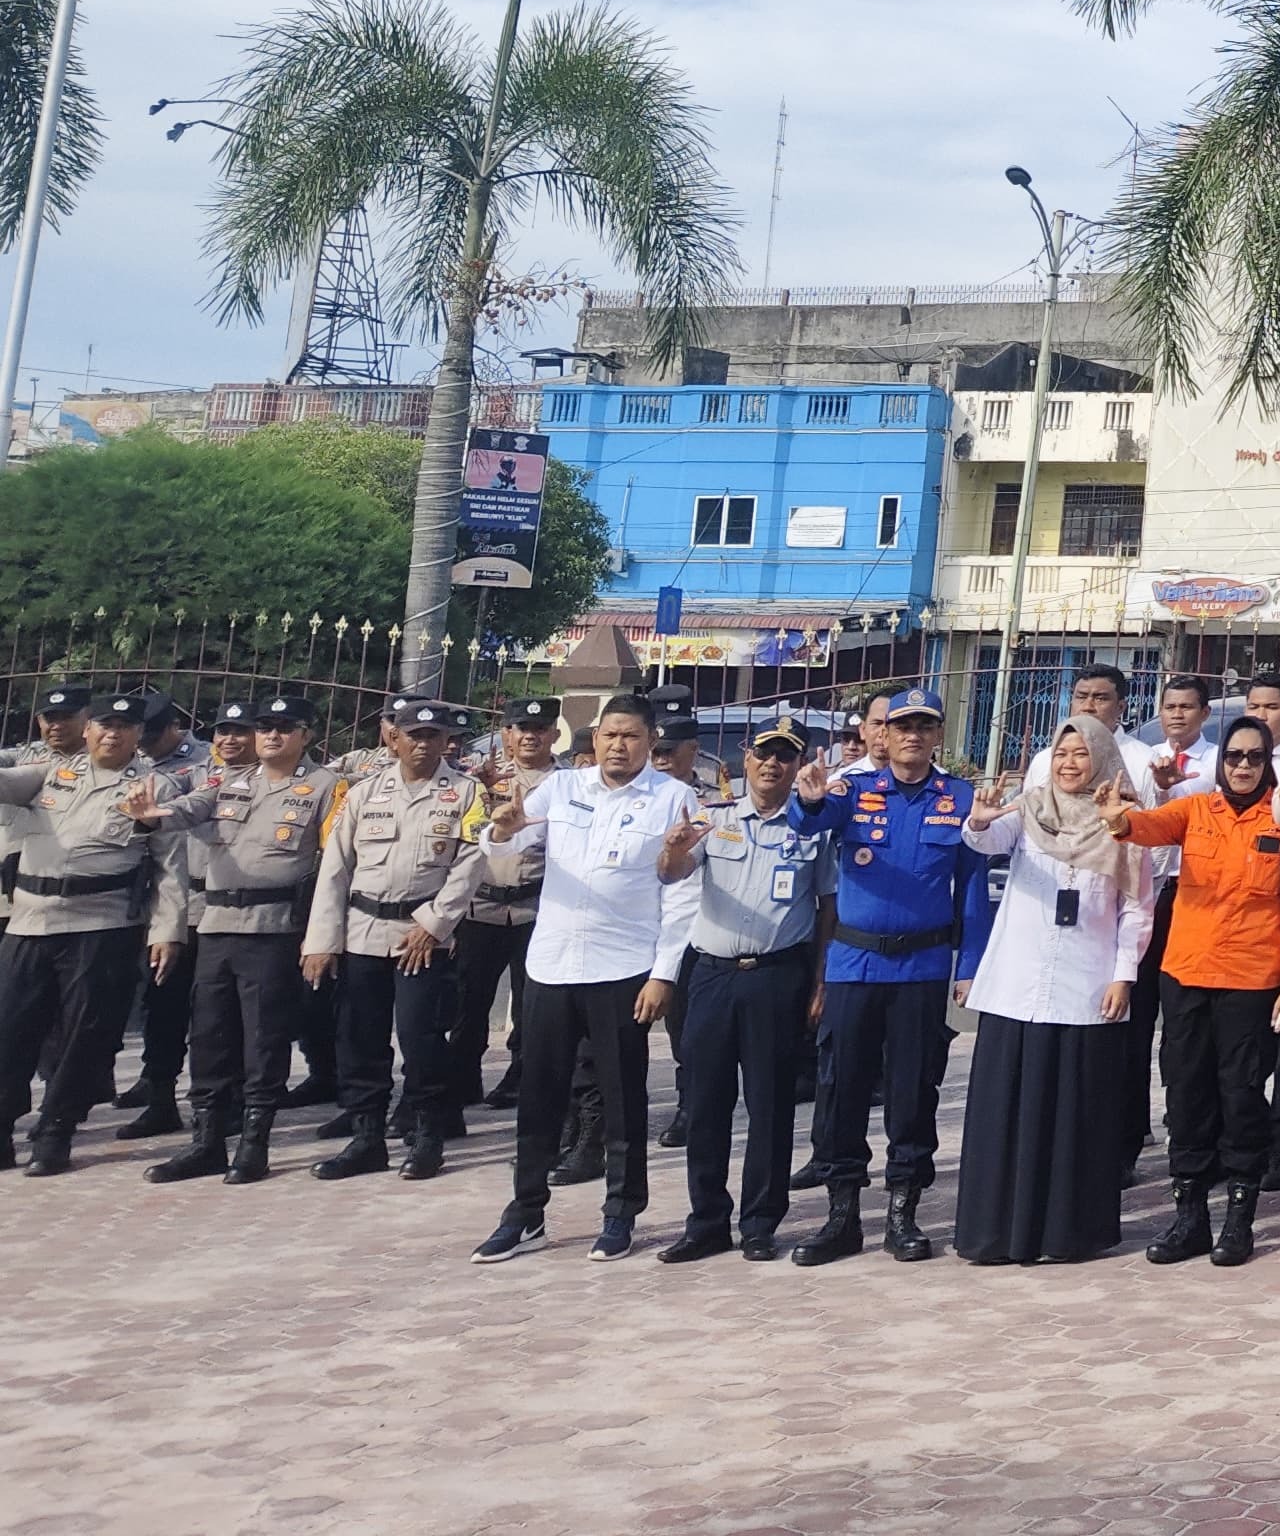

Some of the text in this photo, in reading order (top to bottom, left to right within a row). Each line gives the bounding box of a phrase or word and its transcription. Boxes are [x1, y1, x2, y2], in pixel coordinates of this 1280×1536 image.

[1192, 602, 1226, 610] BAKERY
[281, 798, 314, 809] POLRI
[428, 809, 461, 819] POLRI
